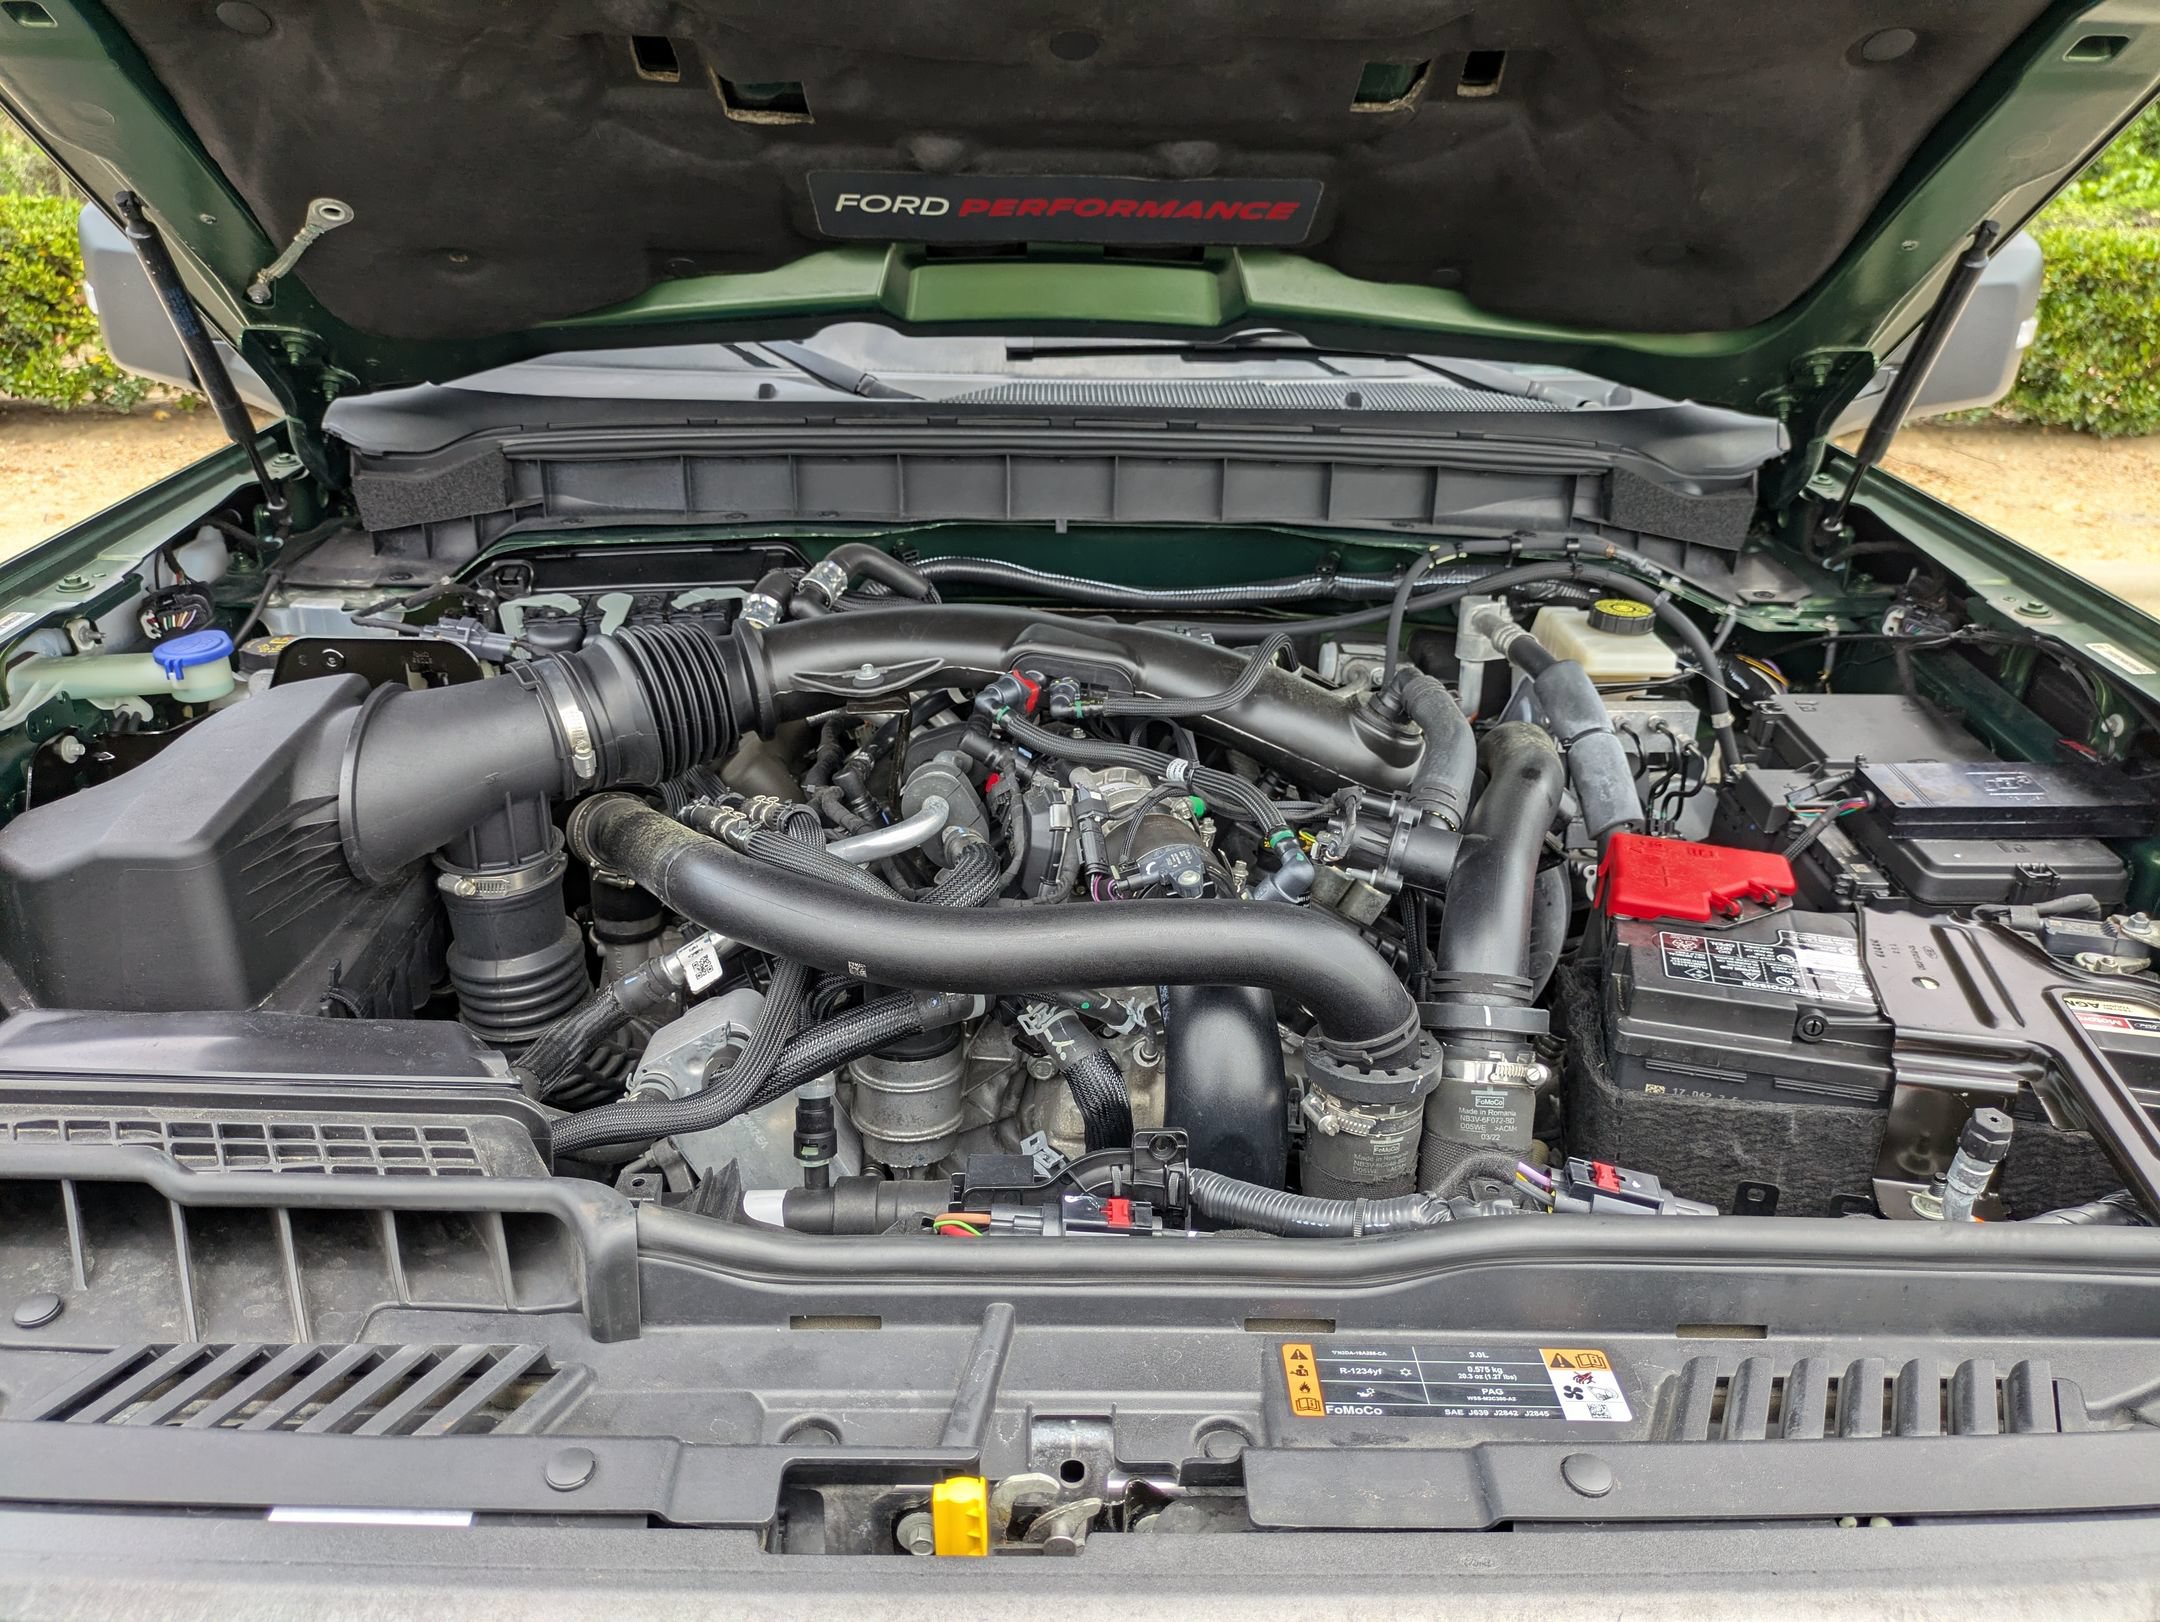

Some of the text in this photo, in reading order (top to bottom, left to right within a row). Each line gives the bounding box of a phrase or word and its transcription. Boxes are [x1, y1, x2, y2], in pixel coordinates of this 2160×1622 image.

[834, 193, 1301, 221] FORD PERFORMANCE
[1475, 1097, 1504, 1106] FoMoCo
[1458, 1106, 1478, 1115] Made
[1488, 1109, 1517, 1117] Romania
[1480, 1133, 1501, 1141] 03/22
[1468, 1351, 1490, 1359] 3.0L
[1339, 1367, 1383, 1377] R-1234yf
[1466, 1365, 1504, 1376] 0.575 kg
[1484, 1373, 1502, 1381] (1.27
[1481, 1388, 1504, 1396] PAG
[1325, 1405, 1383, 1416] FoMoCo
[1444, 1408, 1465, 1416] SAE
[1468, 1409, 1490, 1417] J639
